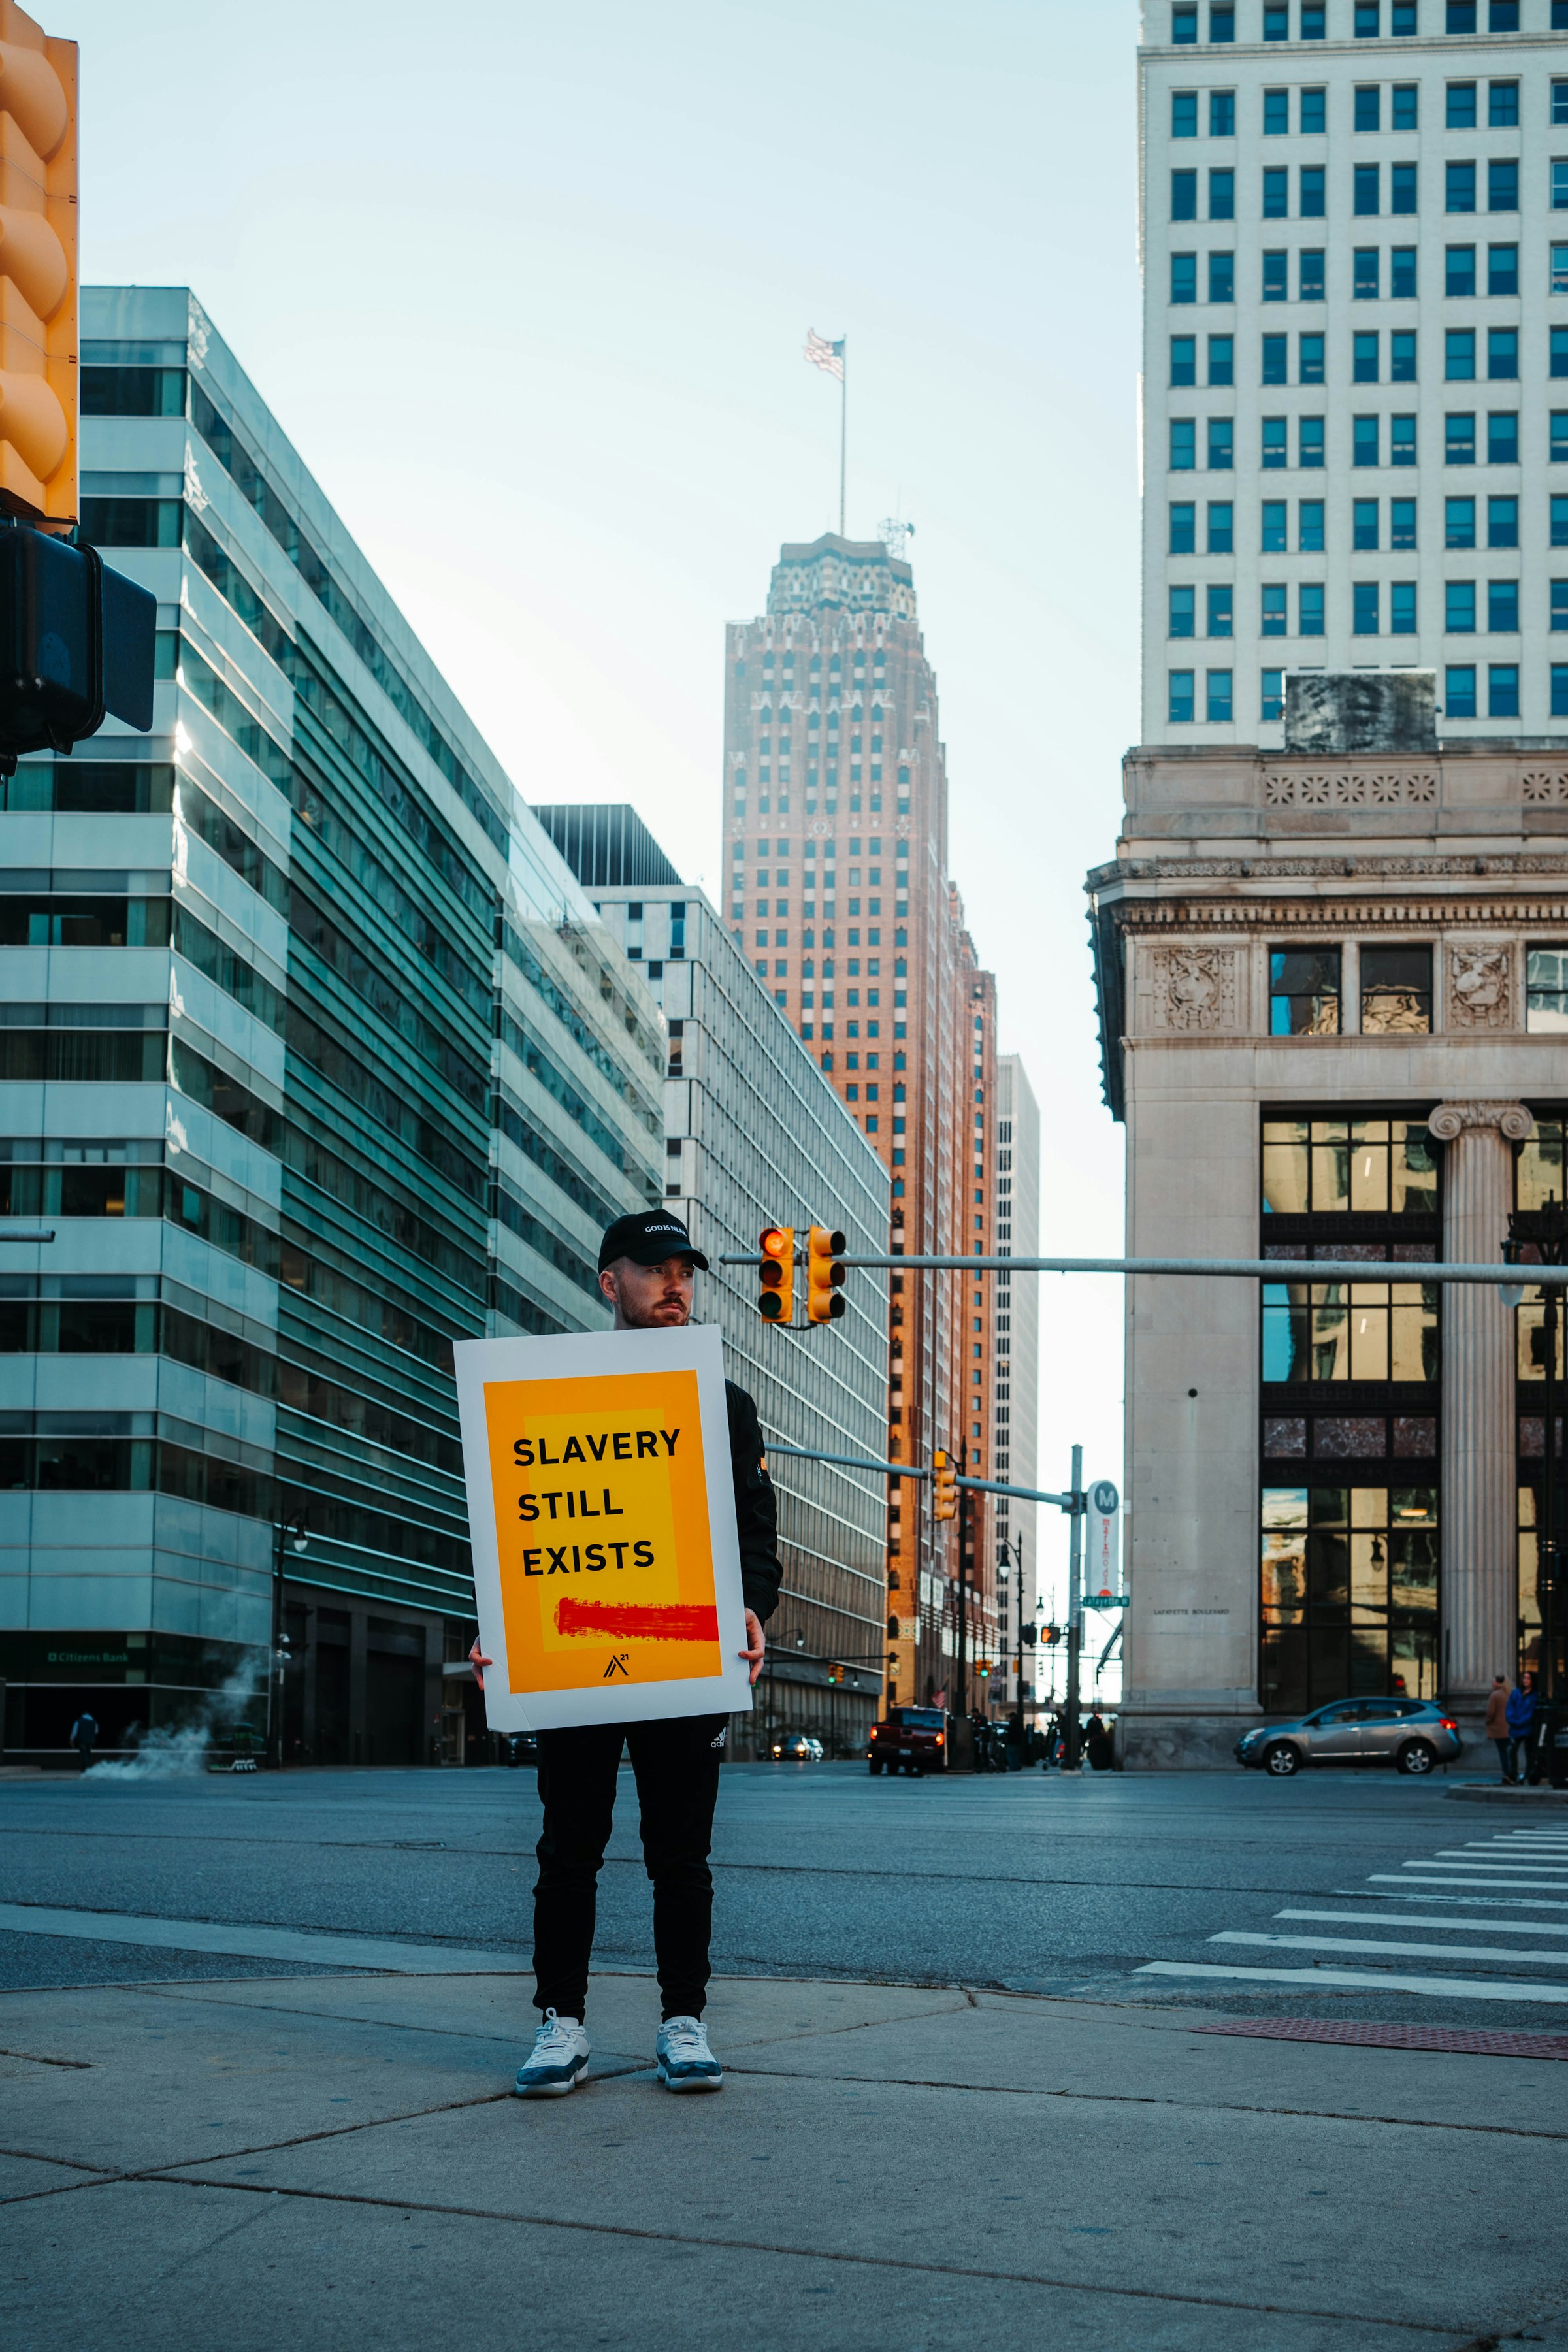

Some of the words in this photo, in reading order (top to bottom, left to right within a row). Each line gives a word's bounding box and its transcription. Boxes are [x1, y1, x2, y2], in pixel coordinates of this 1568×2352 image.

[513, 1429, 680, 1467] SLAVERY
[518, 1488, 623, 1522] STILL
[1099, 1489, 1115, 1507] M
[523, 1540, 655, 1576] EXISTS
[59, 1652, 101, 1662] Citizens
[103, 1652, 129, 1662] Bank
